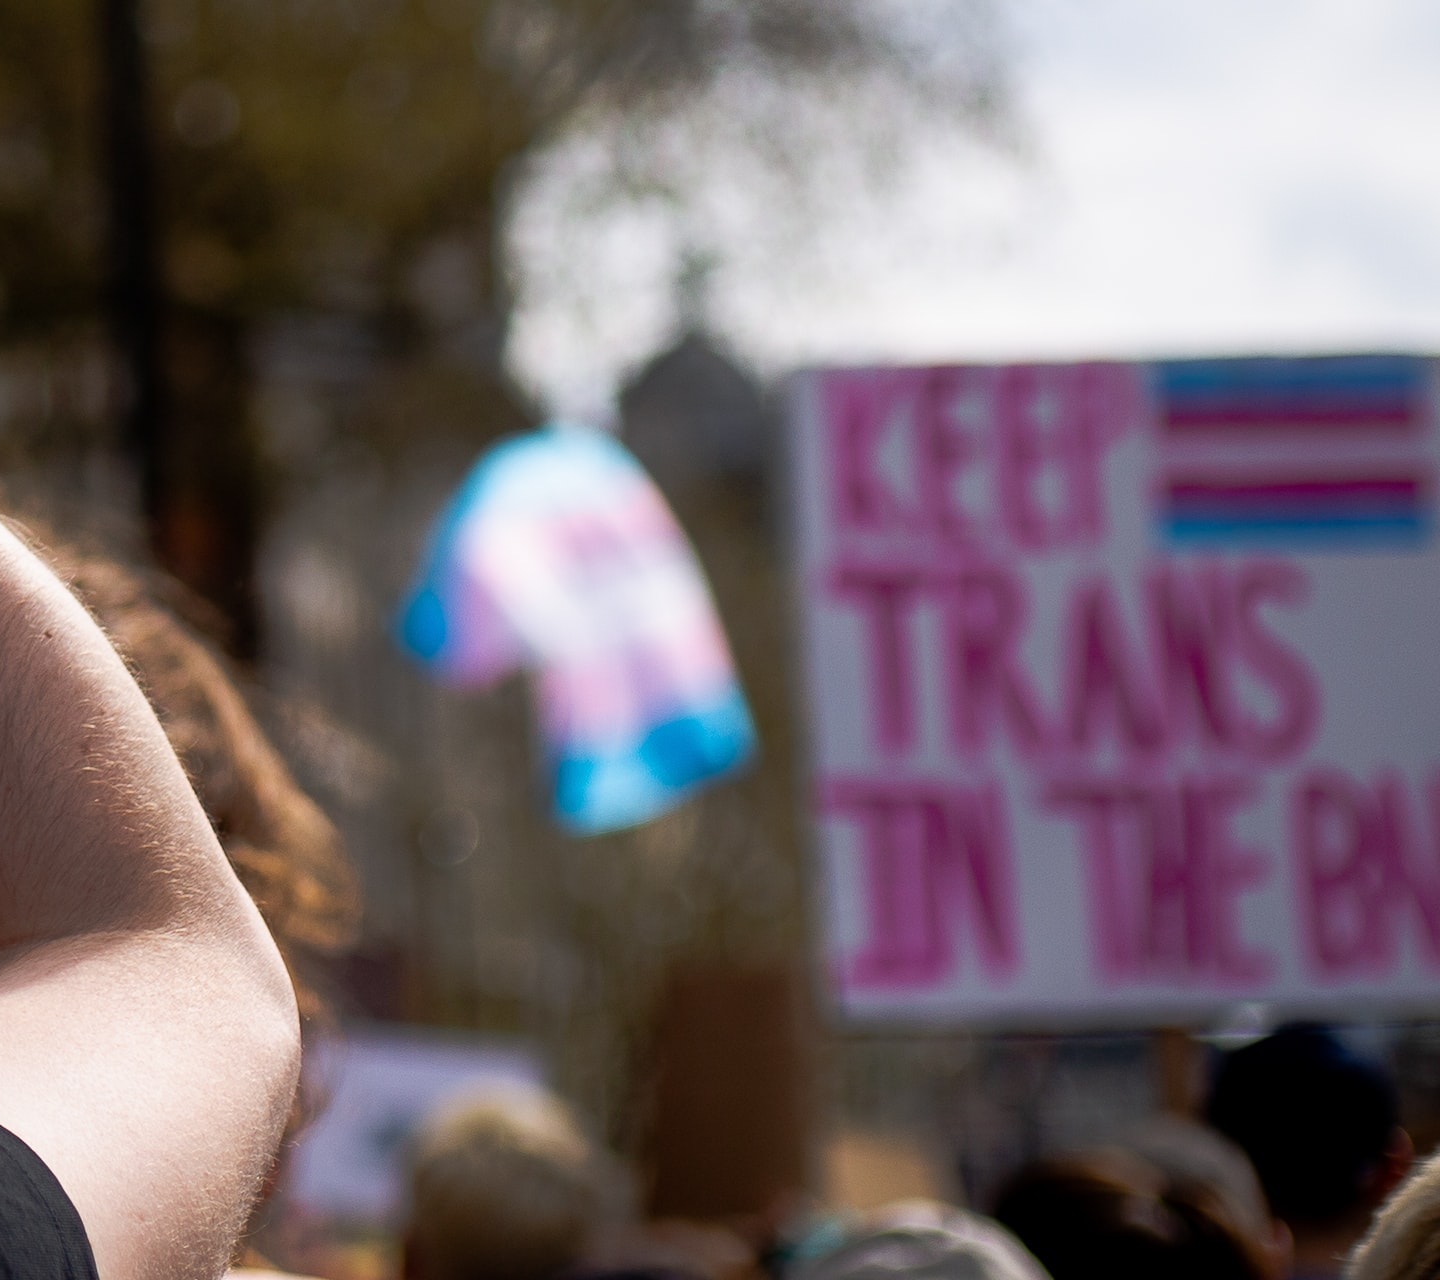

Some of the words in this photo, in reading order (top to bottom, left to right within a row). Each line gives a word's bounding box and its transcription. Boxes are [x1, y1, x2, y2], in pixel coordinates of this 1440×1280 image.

[822, 363, 1144, 548] KEEP
[828, 556, 1321, 771] TRANS
[821, 774, 1018, 989] IN
[1040, 774, 1278, 989] THE
